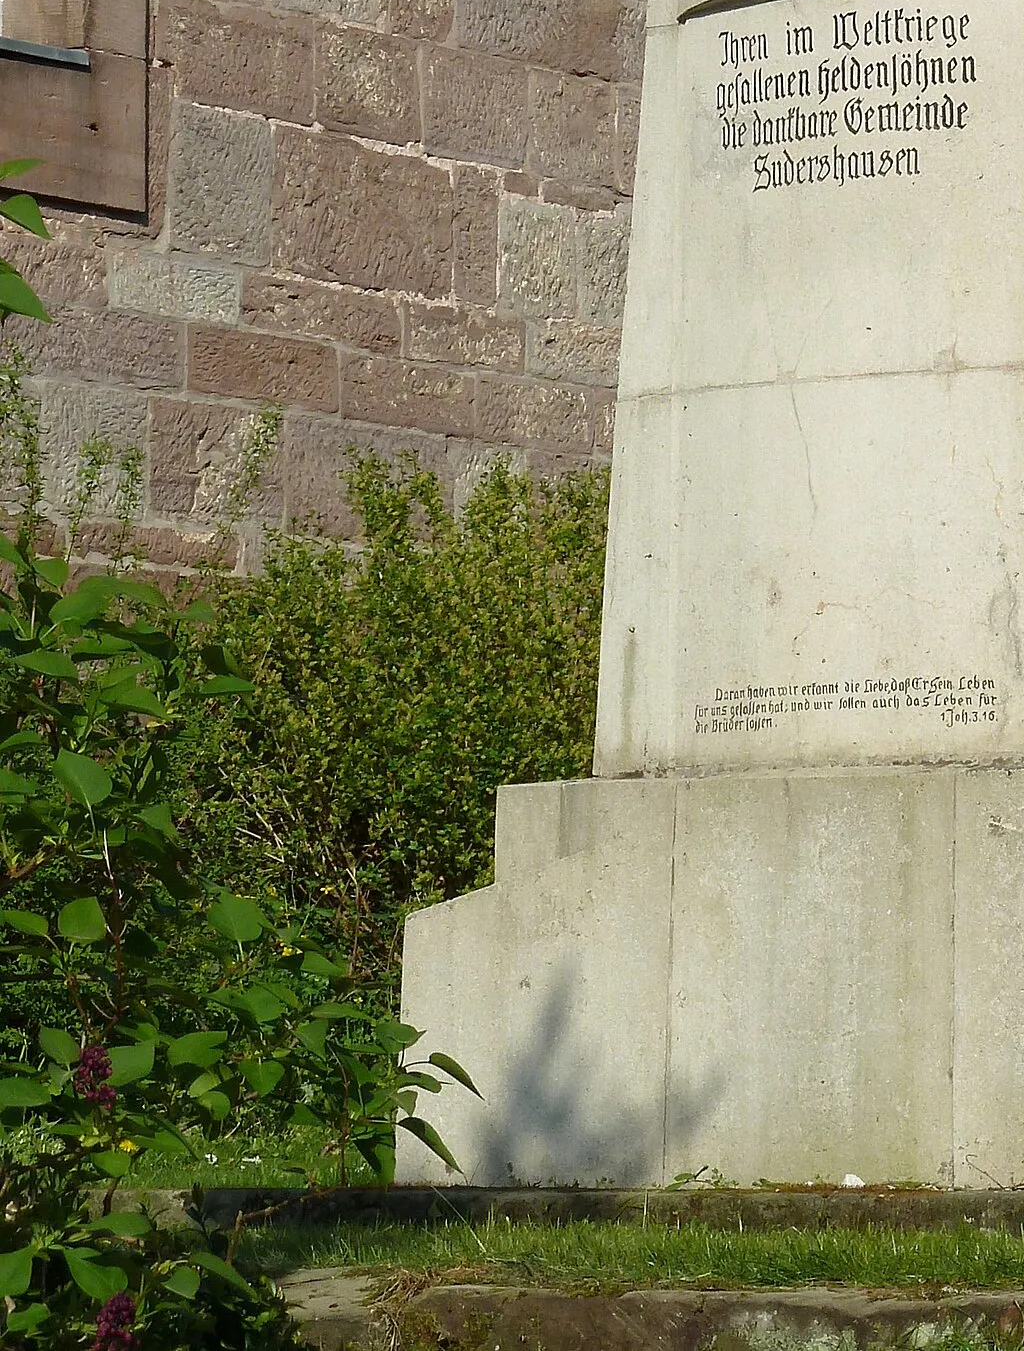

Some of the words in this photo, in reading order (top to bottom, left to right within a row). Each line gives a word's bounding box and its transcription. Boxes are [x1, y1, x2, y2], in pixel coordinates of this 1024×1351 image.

[718, 29, 769, 68] Ihren
[786, 21, 815, 57] im
[832, 7, 971, 51] Weltkriege
[715, 66, 812, 116] gefallenen
[720, 115, 747, 151] die
[751, 107, 839, 148] dankbare
[843, 93, 970, 136] Gemeinde
[752, 144, 922, 193] Sudershausen
[710, 705, 727, 717] uns
[730, 701, 767, 720] gelassen
[791, 698, 810, 712] und
[813, 697, 833, 710] wir
[839, 696, 866, 711] sollen
[872, 694, 900, 709] auch
[905, 694, 930, 708] das
[934, 692, 972, 706] Leben
[714, 688, 745, 701] Daran
[747, 684, 776, 700] haben
[777, 683, 798, 697] wir
[801, 681, 839, 696] erkannt
[844, 679, 860, 693] die
[911, 677, 929, 690] Er
[928, 676, 953, 695] Sein
[958, 674, 996, 690] Leben
[695, 719, 709, 734] die
[711, 718, 744, 733] Brüder
